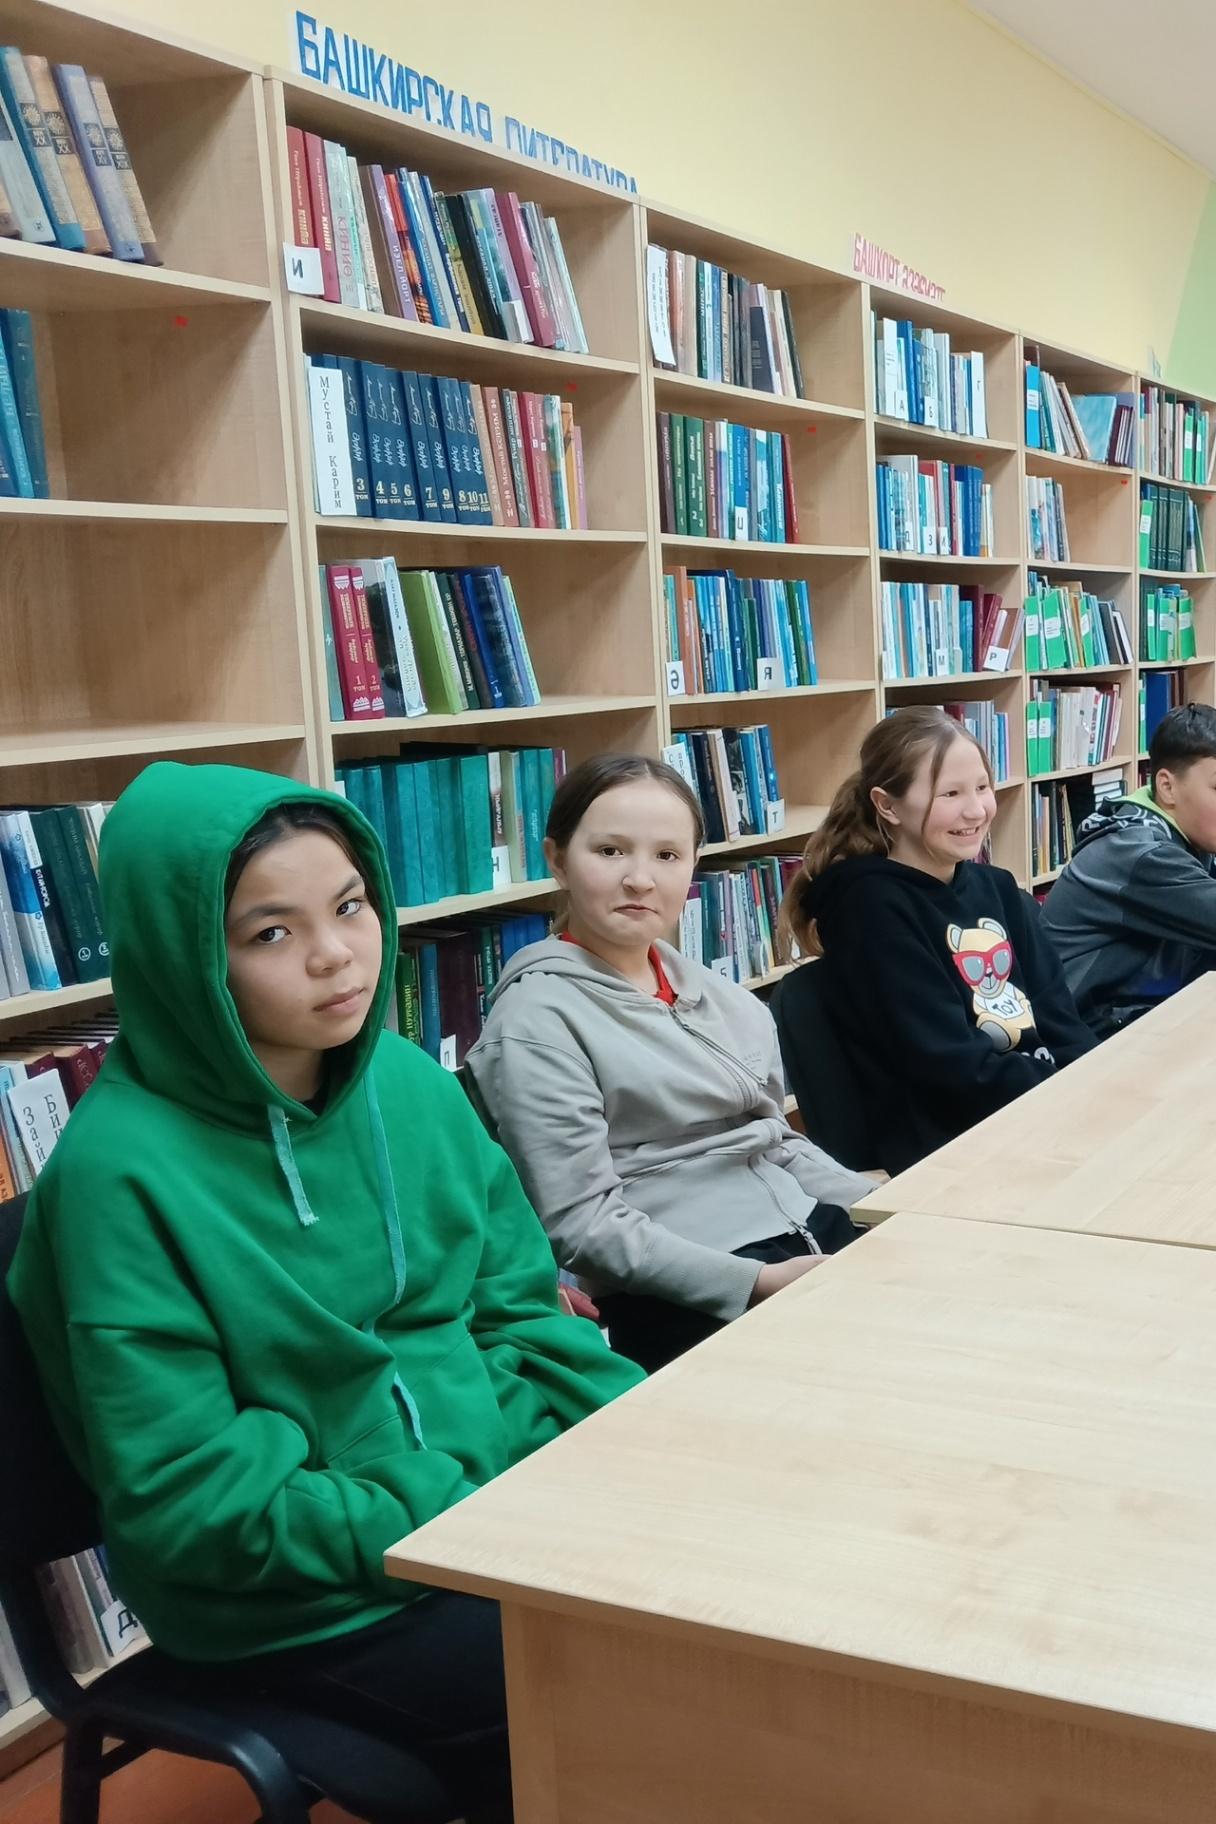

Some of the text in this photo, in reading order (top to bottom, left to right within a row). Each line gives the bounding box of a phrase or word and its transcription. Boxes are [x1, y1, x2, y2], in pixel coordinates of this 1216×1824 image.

[296, 10, 493, 144] БАШКИРСКАЯ
[319, 375, 343, 509] Мустай Карим
[356, 478, 365, 491] 3
[375, 481, 385, 494] 4
[390, 483, 398, 494] 5
[403, 484, 412, 497] 6
[425, 487, 433, 499] 7
[442, 488, 450, 501] 9
[458, 490, 467, 502] 8
[467, 491, 478, 503] 10
[479, 493, 489, 504] 11
[991, 999, 1018, 1017] Toy
